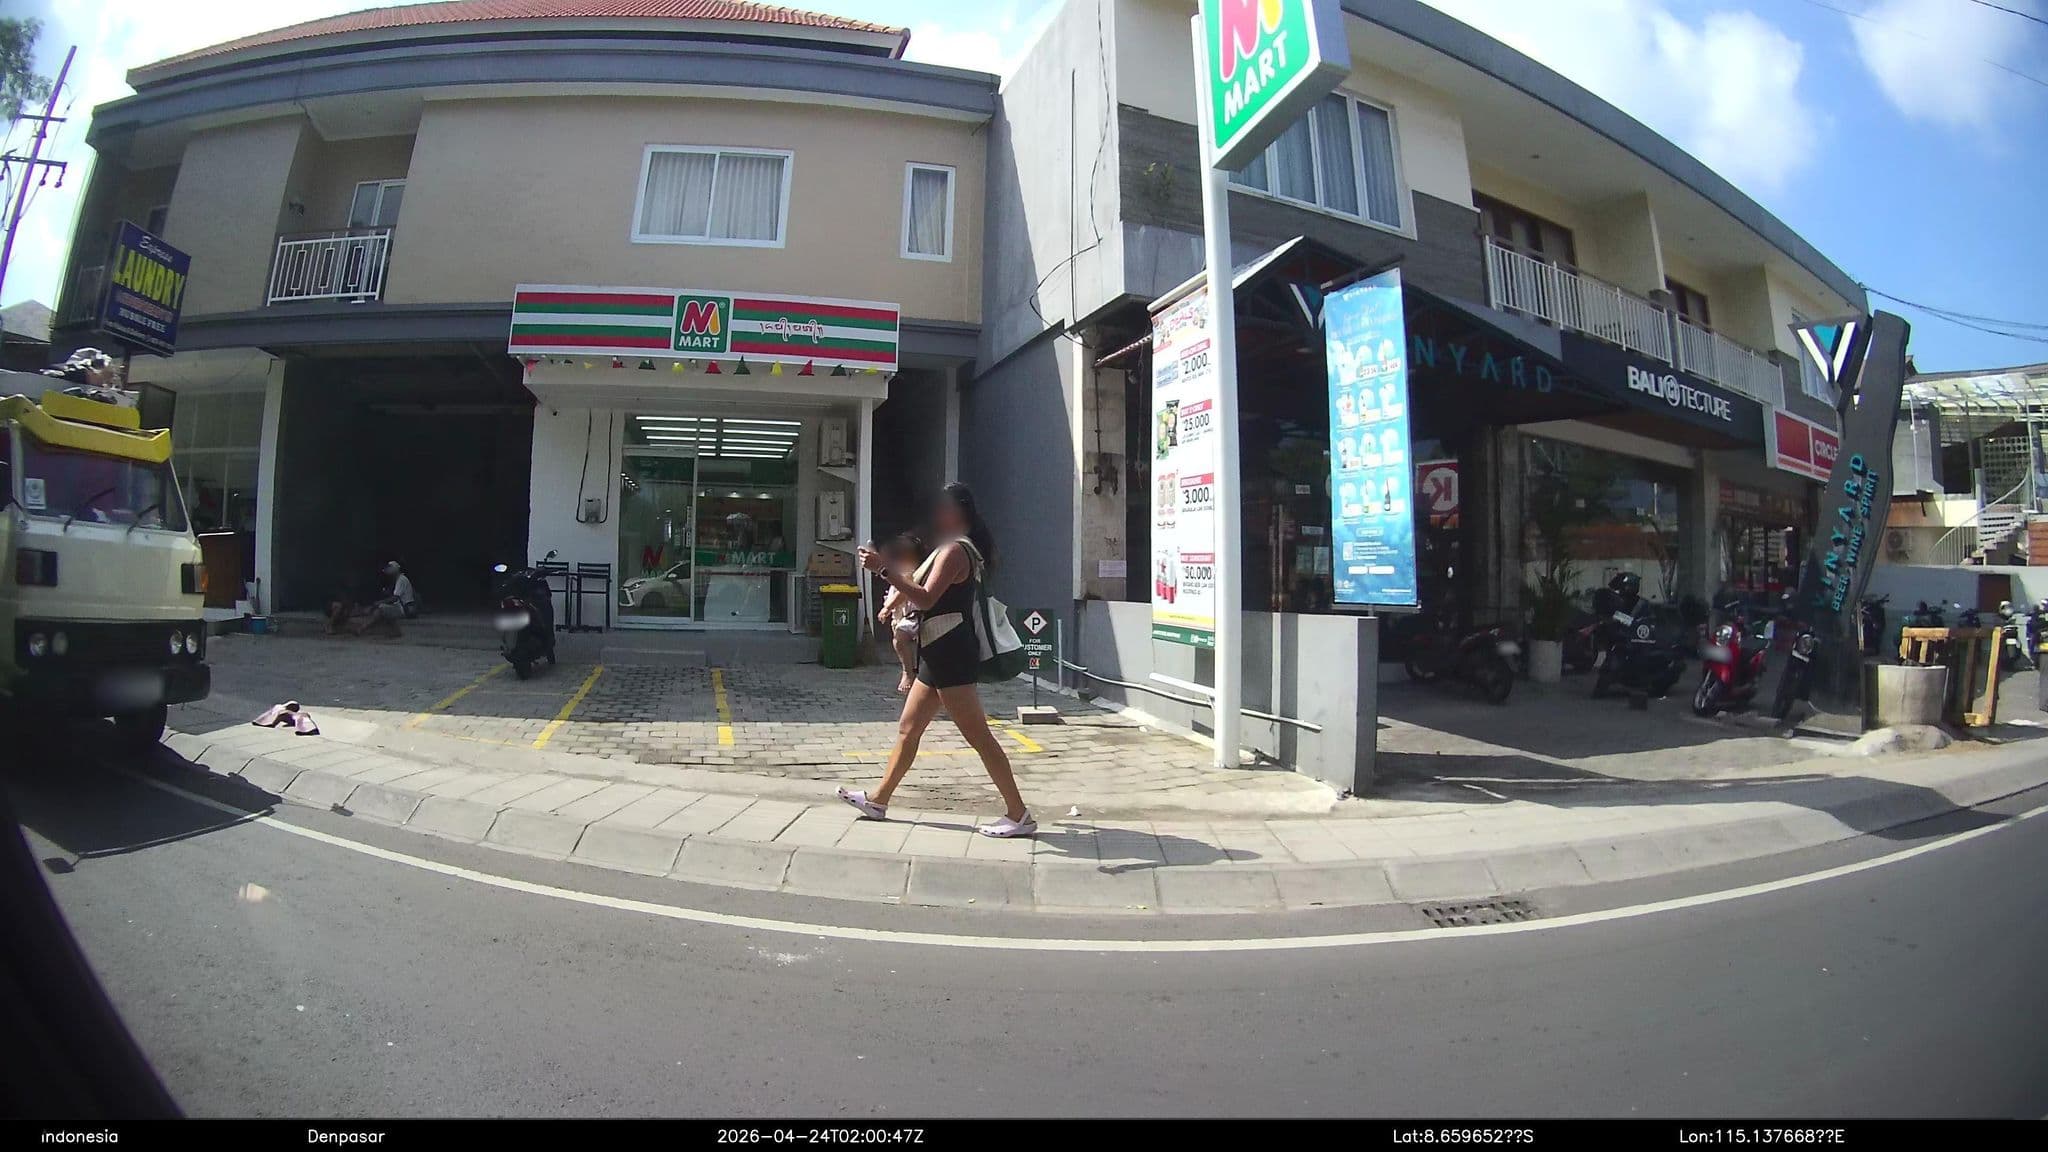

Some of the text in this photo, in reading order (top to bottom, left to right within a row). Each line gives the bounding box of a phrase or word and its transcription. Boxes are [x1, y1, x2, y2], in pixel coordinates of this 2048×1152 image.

[1224, 30, 1287, 124] MART
[112, 244, 185, 310] LAUNDRY
[679, 336, 720, 348] MART
[1413, 335, 1551, 393] NYARD
[731, 551, 776, 564] MART
[1832, 468, 1879, 611] BEER WINE SPIRIT
